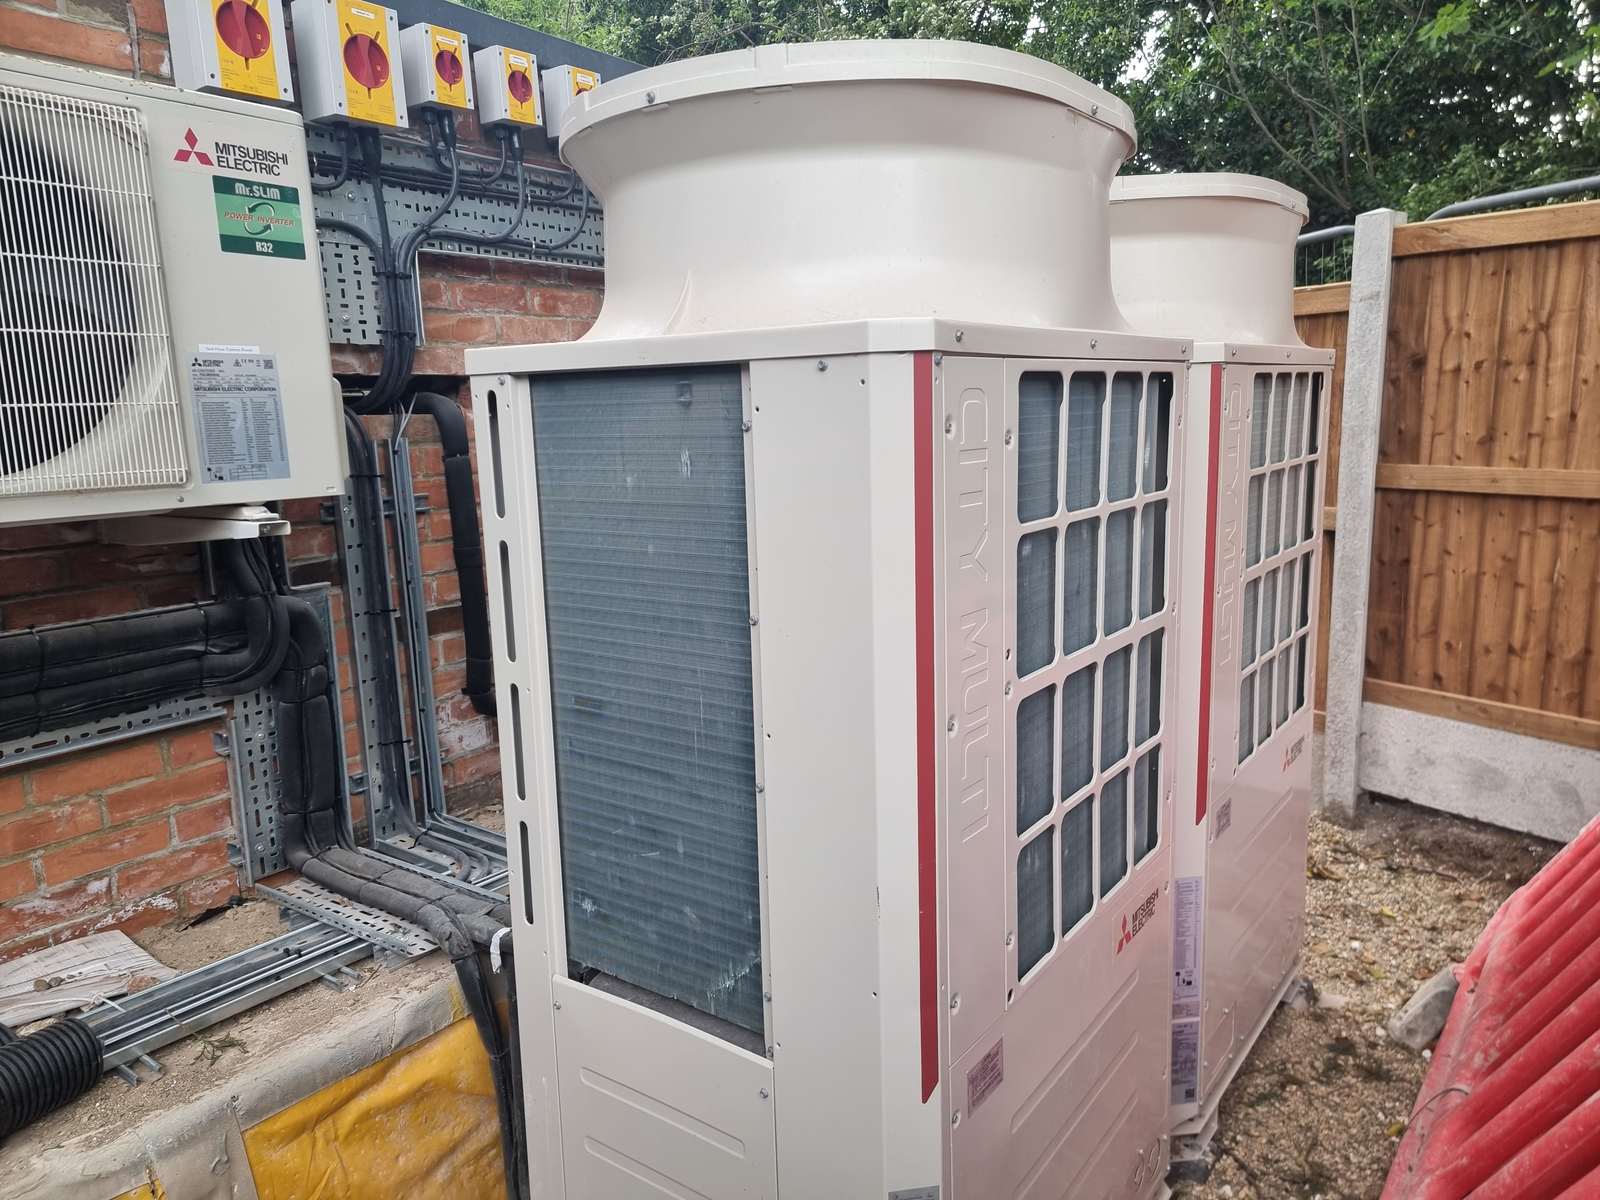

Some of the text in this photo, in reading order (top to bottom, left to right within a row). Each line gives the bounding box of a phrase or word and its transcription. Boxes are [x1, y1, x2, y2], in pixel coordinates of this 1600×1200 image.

[215, 142, 288, 165] MITSUBISHI
[217, 156, 280, 176] ELECTRIC
[235, 182, 280, 200] Mr.SLIM
[224, 211, 294, 227] POWER INVERTER
[959, 387, 990, 844] CITY MULTI
